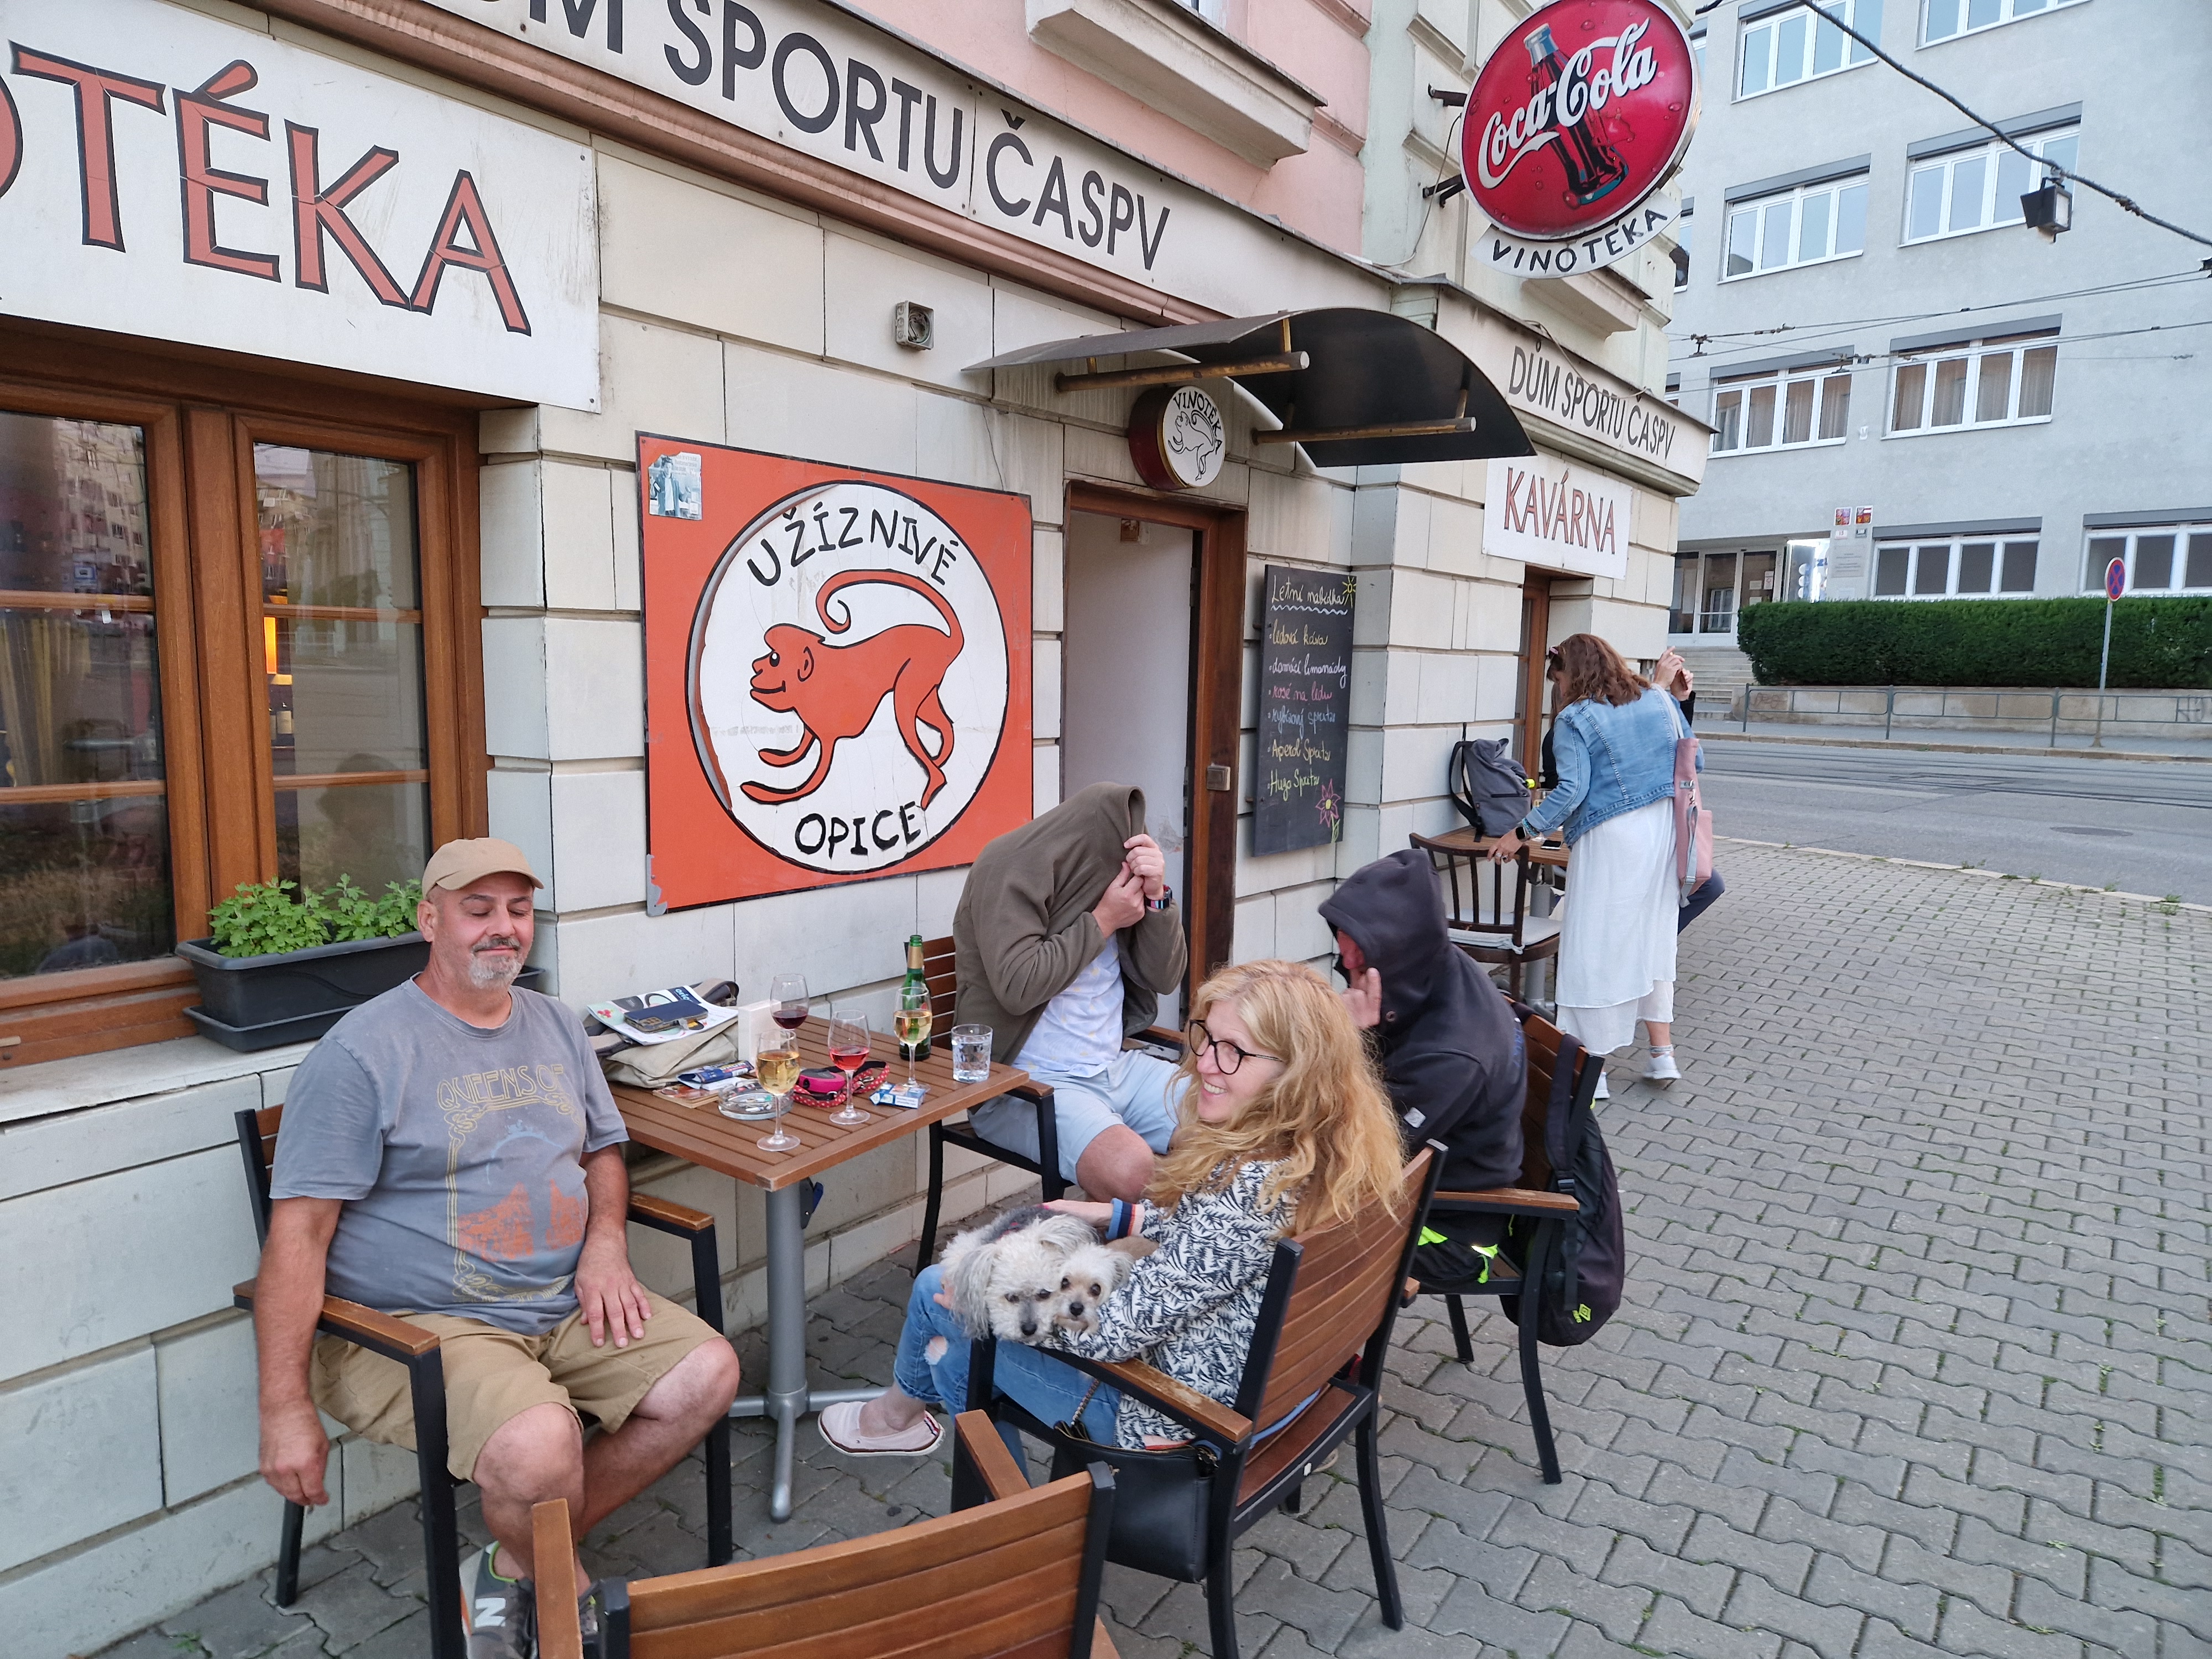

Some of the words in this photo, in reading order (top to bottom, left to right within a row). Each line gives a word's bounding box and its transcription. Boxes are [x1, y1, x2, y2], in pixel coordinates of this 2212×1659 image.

[1478, 18, 1658, 189] Coca-Cola
[664, 0, 963, 189] SPORTU
[987, 108, 1171, 270] ČASPV
[0, 40, 531, 337] TÉKA
[1509, 340, 1561, 411] DŮM
[1561, 372, 1626, 440] SPORTU
[1627, 395, 1676, 460] ČASPV
[1504, 467, 1615, 555] KAVÁRNA
[1272, 575, 1303, 603] Letní
[1272, 618, 1298, 645] ledová
[1272, 657, 1301, 674] domácí
[1304, 653, 1348, 689] limonády
[1272, 682, 1292, 700] rosé
[1295, 691, 1308, 701] na
[1311, 681, 1333, 701] ledu
[1272, 738, 1301, 762] Aperol
[1270, 768, 1292, 801] Hugo
[795, 801, 922, 859] OPICE
[675, 988, 693, 1002] orio
[437, 1065, 537, 1110] QUEENS
